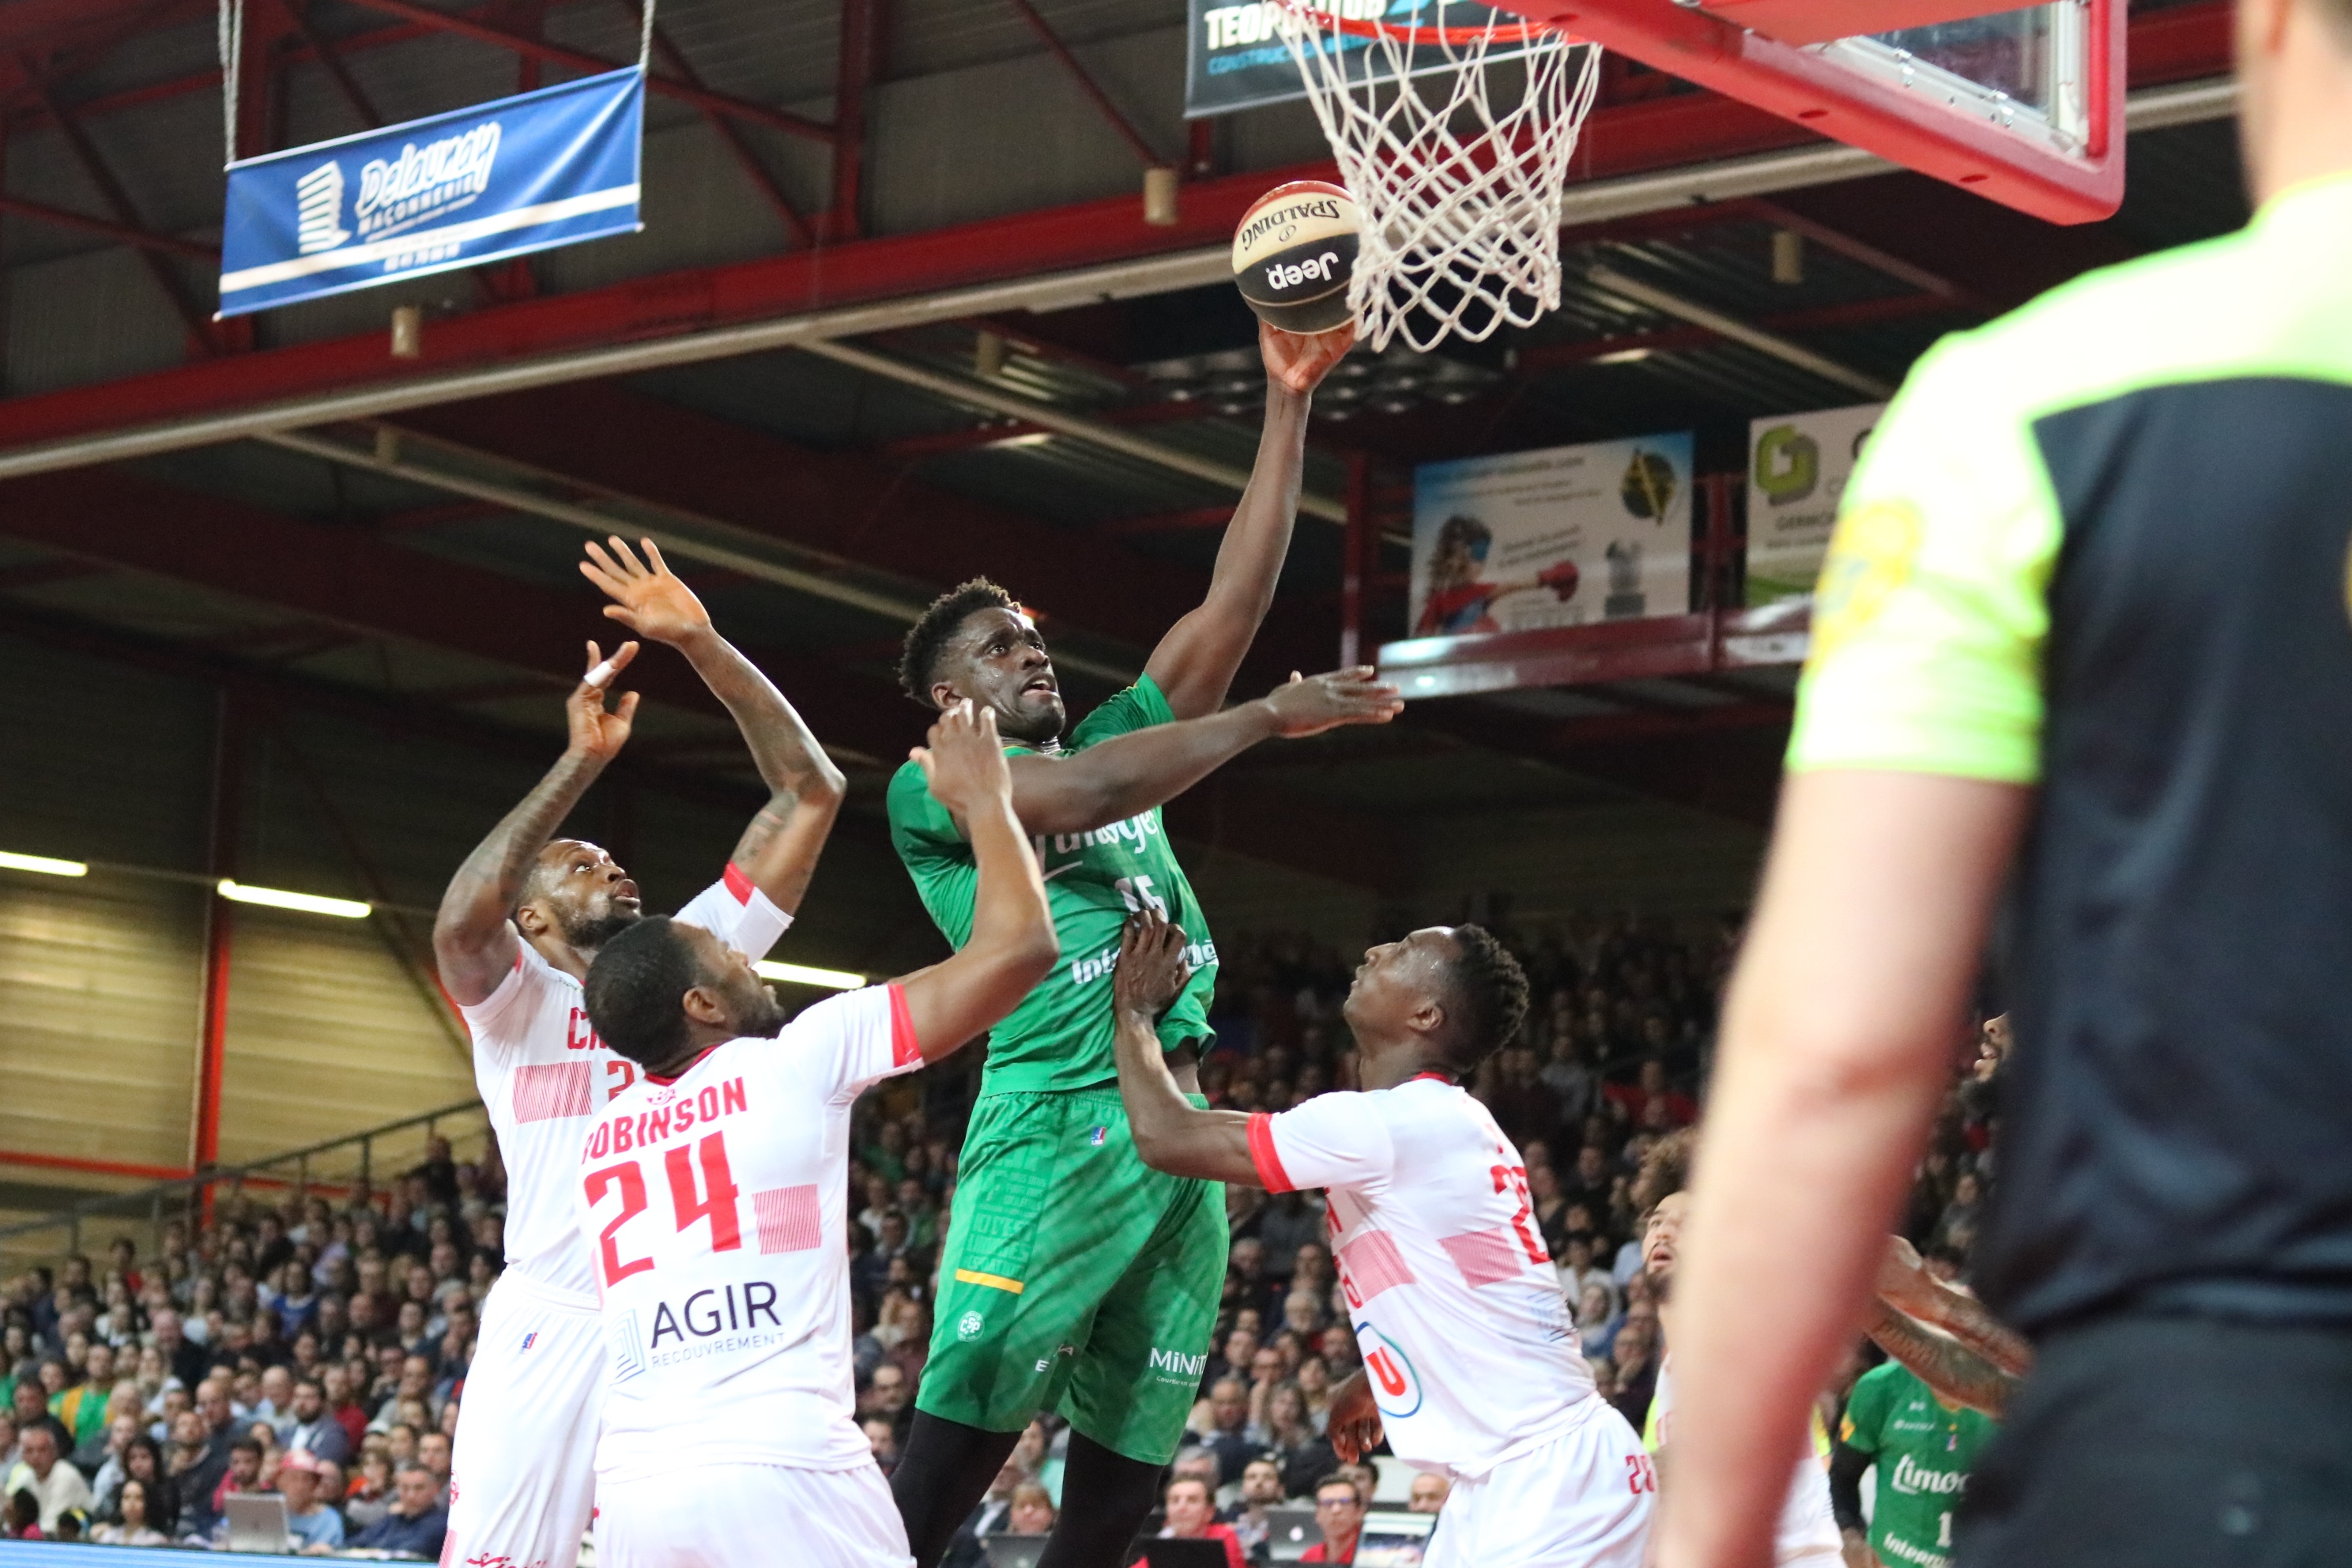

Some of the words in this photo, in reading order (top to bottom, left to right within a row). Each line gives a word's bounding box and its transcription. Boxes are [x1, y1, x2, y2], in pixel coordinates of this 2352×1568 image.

[1242, 200, 1340, 251] SPALDING
[583, 1129, 742, 1289] 24
[651, 1281, 782, 1349] AGIR
[651, 1332, 786, 1368] RECOUVREMENT
